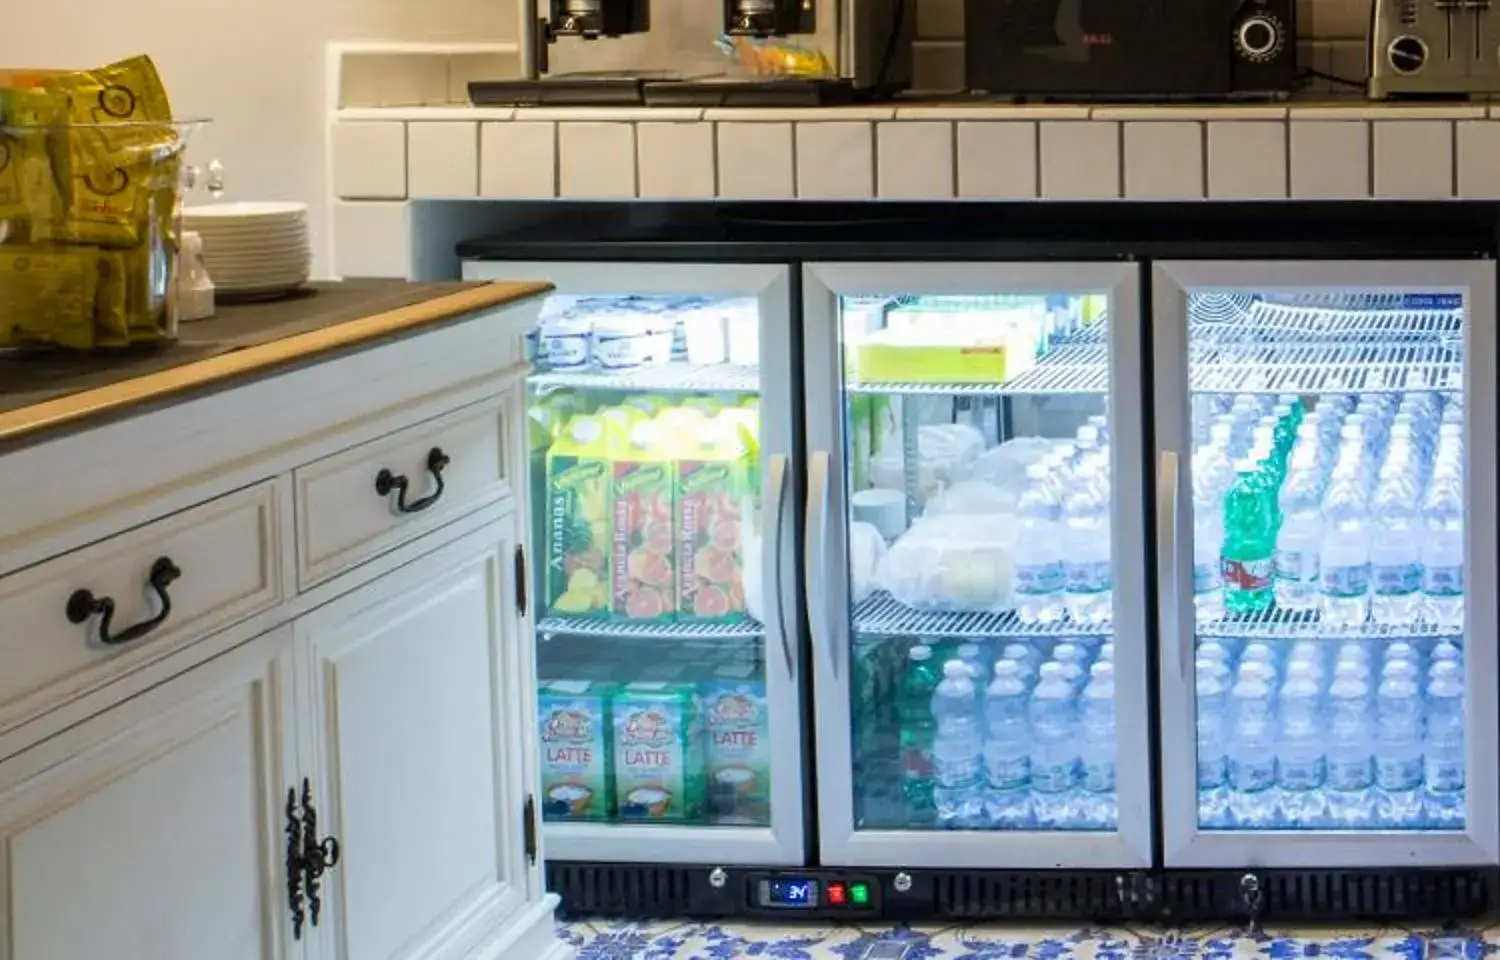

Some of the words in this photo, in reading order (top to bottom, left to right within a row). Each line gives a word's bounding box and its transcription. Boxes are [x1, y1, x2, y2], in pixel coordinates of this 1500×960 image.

[550, 496, 565, 571] Ananas
[713, 731, 757, 746] LATTE
[547, 747, 591, 763] LATTE
[625, 751, 670, 766] LATTE
